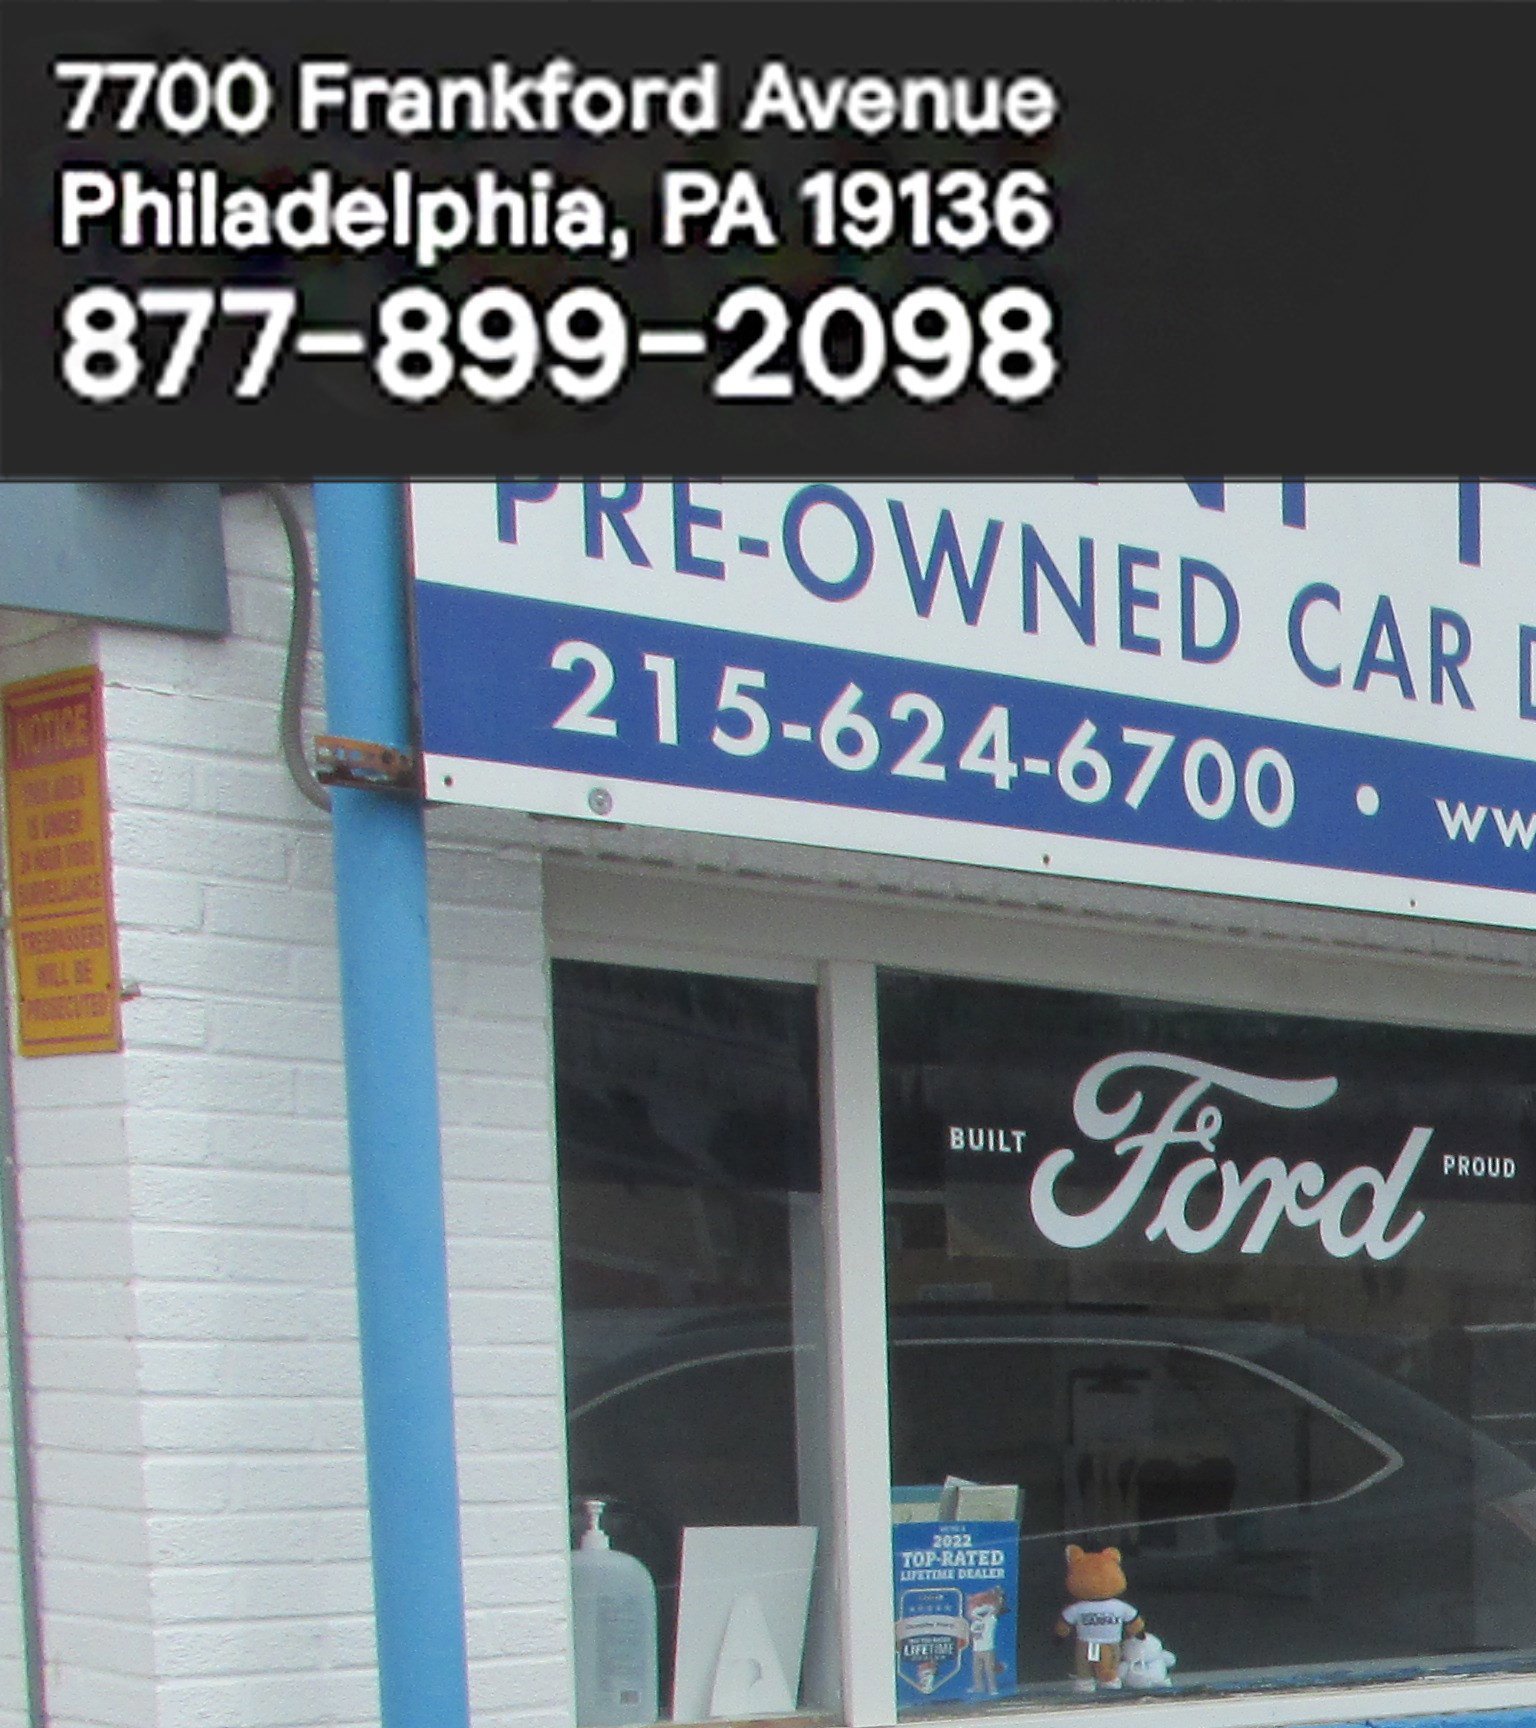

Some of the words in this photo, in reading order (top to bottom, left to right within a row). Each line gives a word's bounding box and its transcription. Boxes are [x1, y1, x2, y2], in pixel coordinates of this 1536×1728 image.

[494, 478, 1241, 665] PRE-OWNED
[1287, 581, 1475, 711] CAR
[16, 705, 88, 755] NOTICE
[548, 639, 1296, 829] 215-624-6700
[949, 1126, 1027, 1154] BUILT
[1029, 1051, 1434, 1261] Ford
[1442, 1154, 1517, 1179] PROUD
[901, 1549, 1006, 1569] TOP-RATED
[932, 1533, 973, 1549] 2022
[899, 1568, 956, 1581] LIFETIME
[958, 1567, 1006, 1580] DEALER
